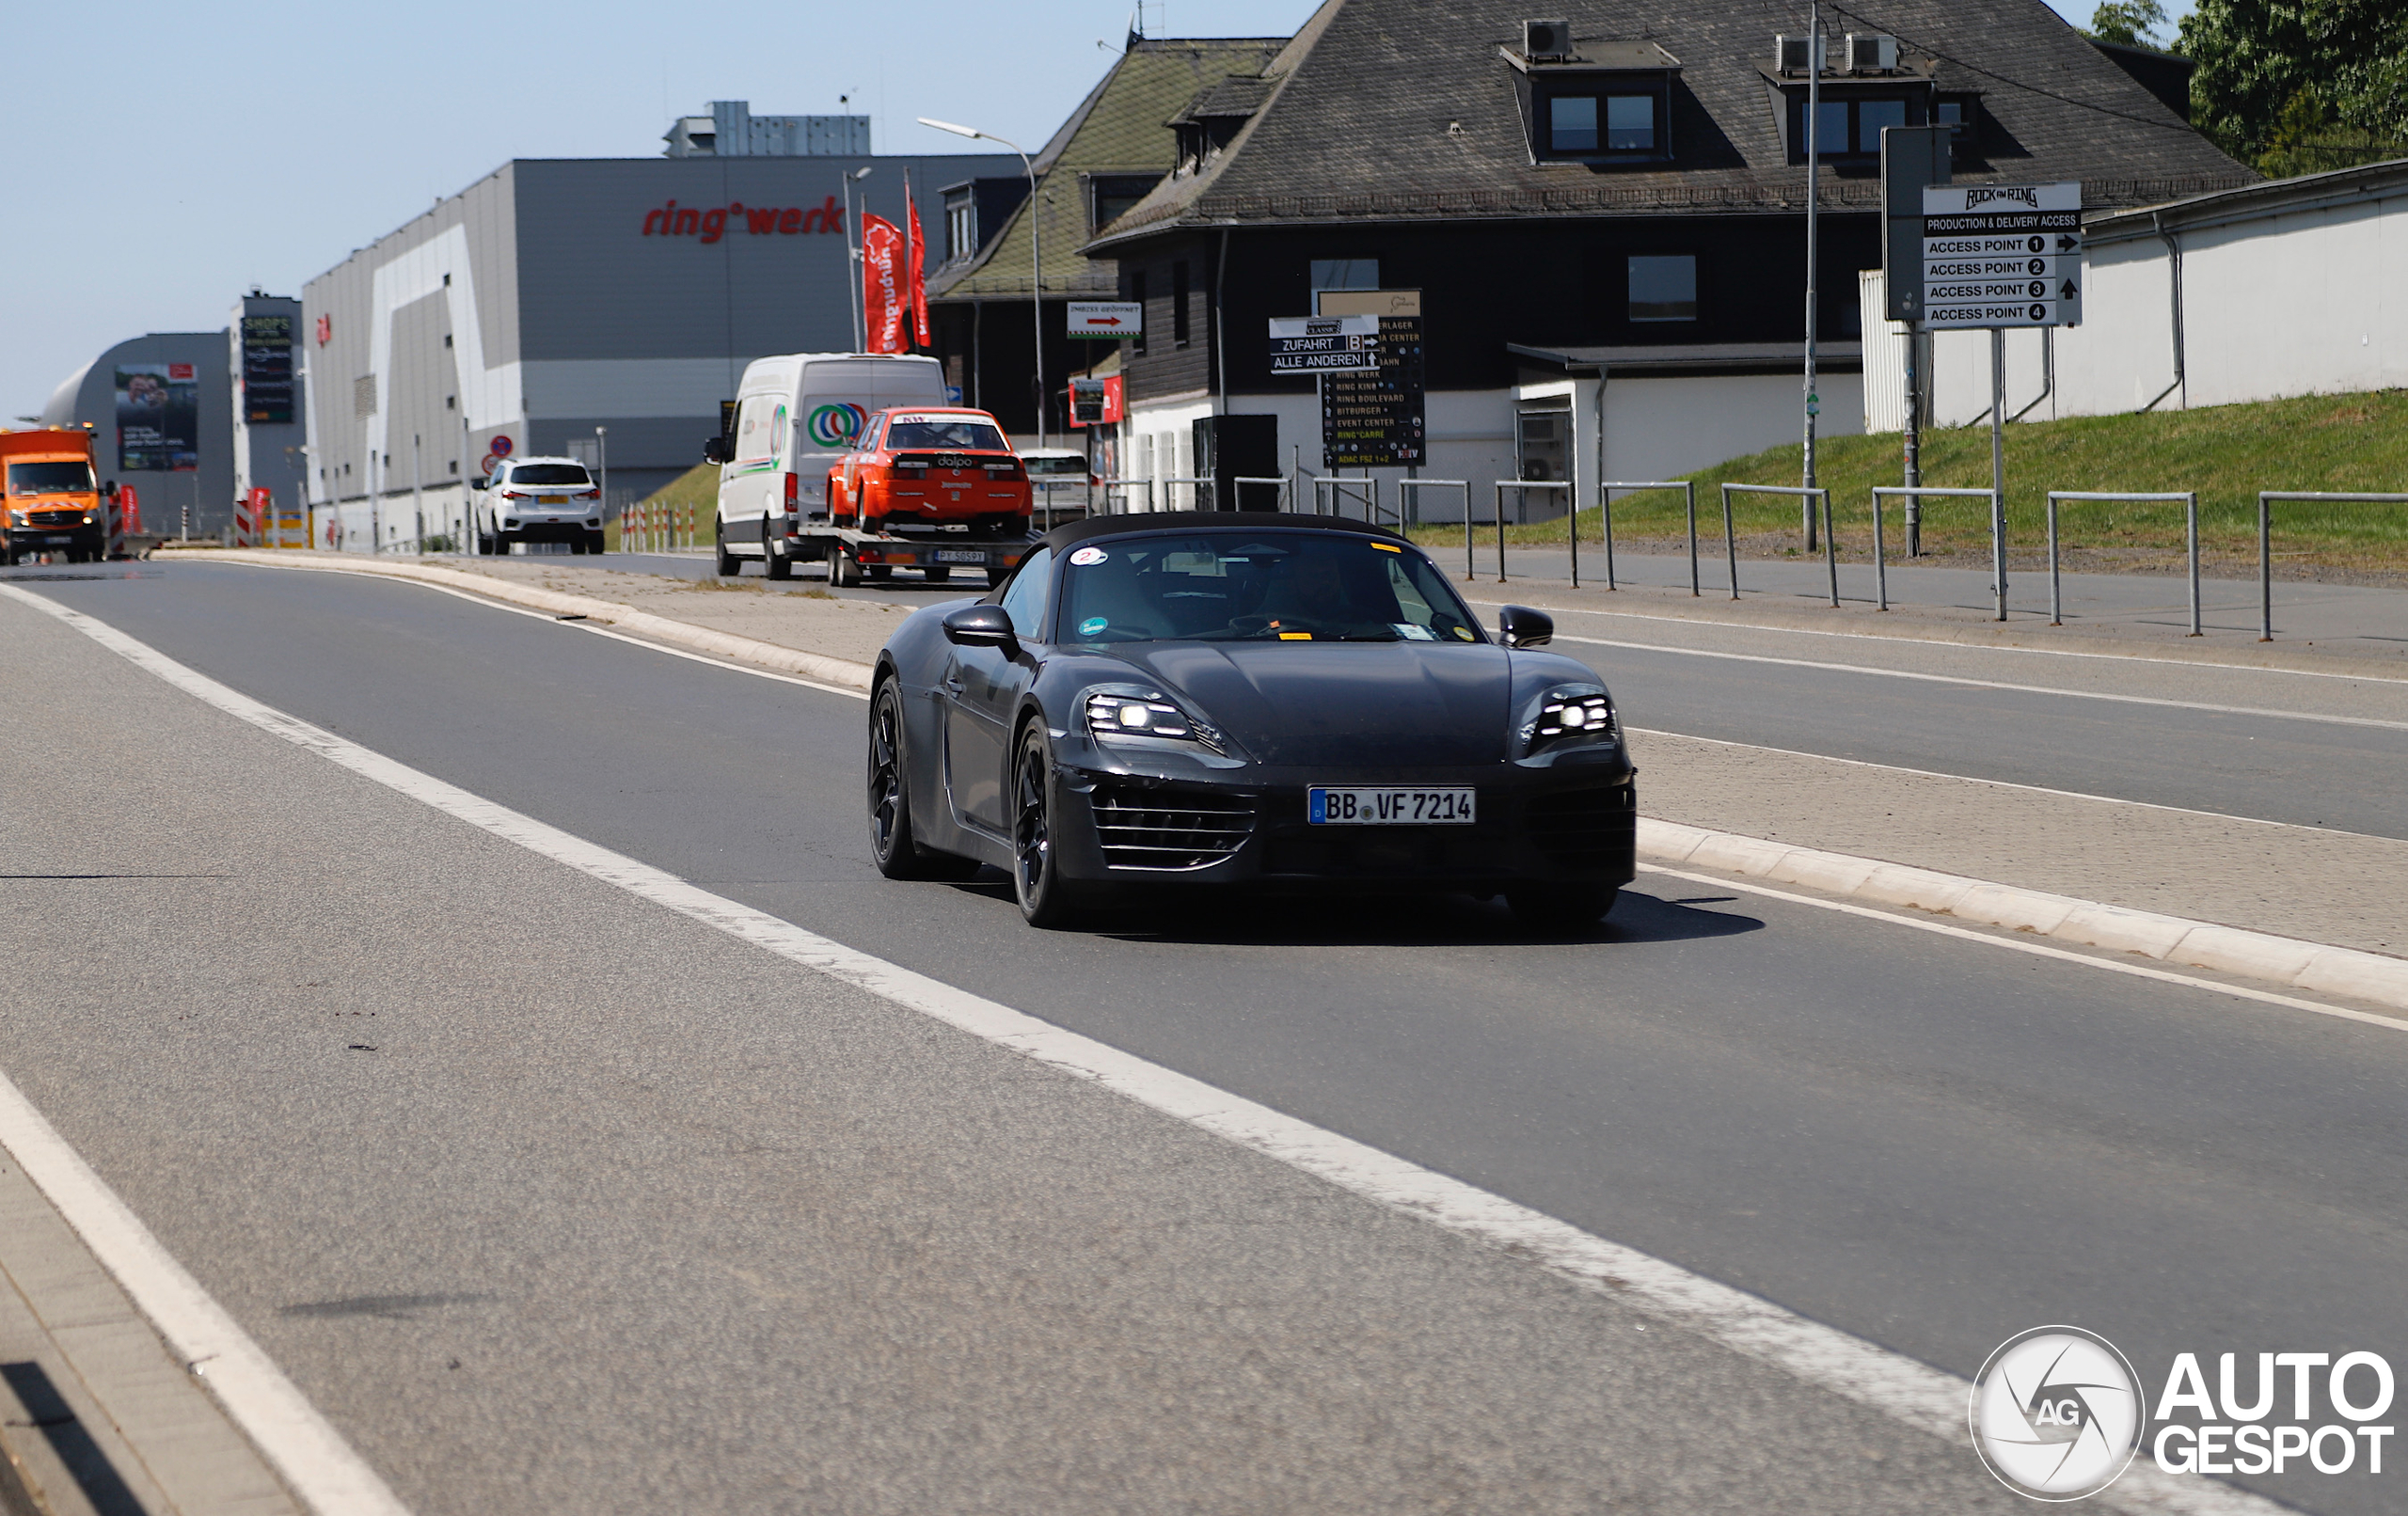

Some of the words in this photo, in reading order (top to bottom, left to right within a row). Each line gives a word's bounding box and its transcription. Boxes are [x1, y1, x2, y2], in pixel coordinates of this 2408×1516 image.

[1966, 189, 1996, 211] ROCK
[2007, 188, 2038, 208] RING
[1928, 218, 1986, 231] PRODUCTION
[1988, 218, 1995, 229] &
[1996, 216, 2039, 228] DELIVERY
[2041, 215, 2076, 227] ACCESS
[1930, 241, 1981, 253] ACCESS
[1985, 239, 2024, 251] POINT
[1930, 264, 1981, 276] ACCESS
[1985, 262, 2024, 274] POINT
[1931, 286, 1982, 298] ACCESS
[1986, 284, 2024, 296] POINT
[1931, 308, 1982, 321] ACCESS
[1986, 307, 2025, 319] POINT
[245, 318, 290, 330] SHOPS
[1282, 339, 1334, 351] ZUFAHRT
[1350, 336, 1361, 350] B
[1275, 356, 1302, 368] ALLE
[1307, 354, 1361, 367] ANDEREN
[1358, 394, 1404, 403] BOULEVARD
[1337, 407, 1381, 416] BITBURGER
[1337, 419, 1362, 428] EVENT
[937, 456, 973, 468] dalpo
[1079, 552, 1091, 561] 2
[1325, 793, 1357, 820] BB
[1377, 793, 1407, 820] VF
[1413, 793, 1471, 820] 7214
